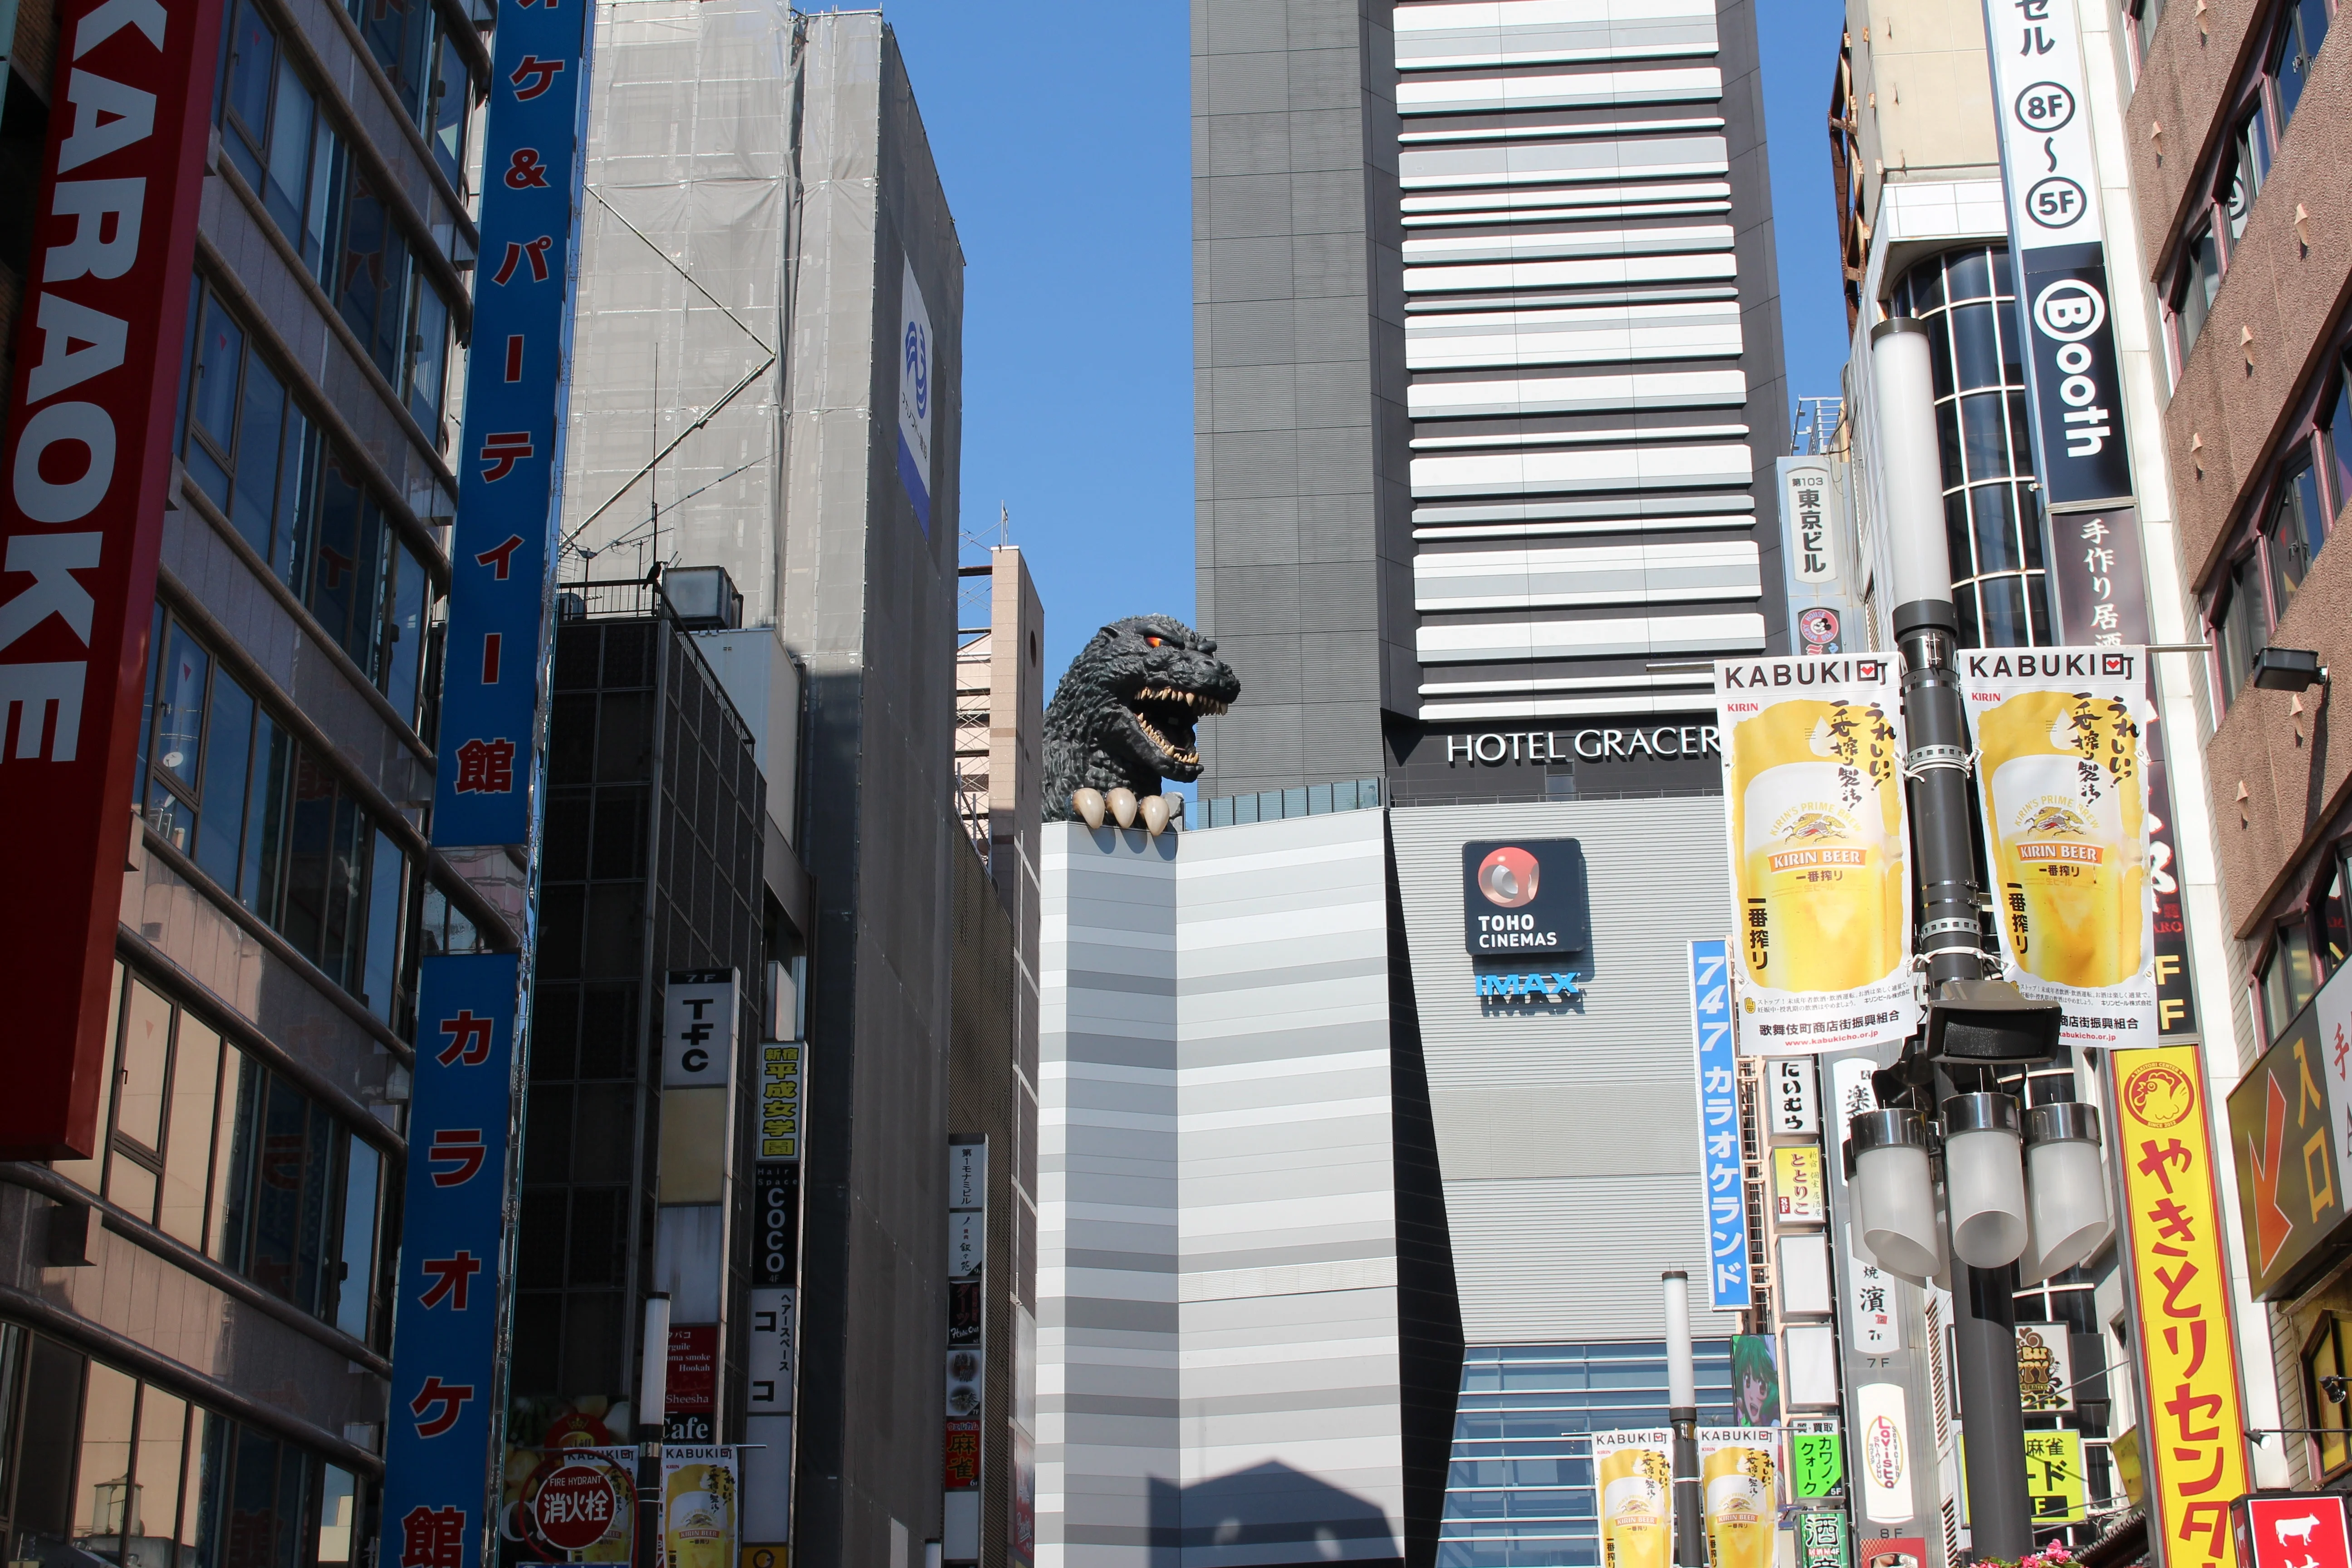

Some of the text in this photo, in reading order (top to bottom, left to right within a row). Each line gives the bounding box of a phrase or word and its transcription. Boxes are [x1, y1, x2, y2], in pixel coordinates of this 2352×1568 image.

[2027, 94, 2063, 120] 8F
[2038, 190, 2075, 216] 5F
[2033, 278, 2111, 458] Booth
[455, 0, 565, 796] ケ&パーティー館
[1792, 477, 1823, 487] 第103
[1797, 488, 1827, 573] 東京ビル
[1725, 659, 1888, 689] KABUKI町
[1969, 653, 2134, 680] KABUKI町
[1727, 702, 1759, 712] KIRIN
[1971, 692, 2001, 701] KIRIN
[1447, 725, 1723, 763] HOTEL GRACER
[1801, 801, 1835, 812] PRIME
[1837, 808, 1863, 833] BREW
[2041, 795, 2074, 808] PRIME
[2077, 804, 2100, 829] BREW
[1774, 850, 1861, 869] KIRIN BEER
[2020, 845, 2097, 861] KIRIN BEER
[1478, 914, 1534, 931] TOHO
[2007, 882, 2029, 955] 一番搾り
[1478, 931, 1557, 949] CINEMAS
[1747, 898, 1769, 970] 一番搾り
[686, 975, 716, 983] 7F
[2157, 954, 2180, 985] F
[1475, 972, 1581, 996] IMAX
[1864, 989, 1911, 1004] キリンビール株式会社
[1759, 1010, 1900, 1037] 歌舞伎町商店街振興組合
[2060, 1015, 2139, 1030] 商店街振興組合
[2161, 998, 2185, 1030] F
[681, 998, 714, 1073] TFC
[1785, 1029, 1879, 1046] www.kabukicho.or.jp
[2333, 1011, 2352, 1083] 手
[764, 1047, 799, 1062] 新宿
[2134, 1062, 2179, 1075] YAKITORI CENTER
[762, 1062, 798, 1156] 平成女学園
[1782, 1062, 1803, 1130] にいむら
[1696, 956, 1743, 1294] 747 カラオケランド
[2293, 1037, 2334, 1224] 入口
[961, 1148, 972, 1205] 第1モナミビル
[1790, 1152, 1809, 1216] ととりこ
[1780, 1197, 1789, 1214] 8F
[766, 1187, 785, 1273] COCO
[401, 1009, 495, 1568] カラオケ館
[769, 1274, 780, 1283] 4F
[1859, 1285, 1886, 1313] 濱
[779, 1294, 791, 1372] ヘアースペース
[1868, 1329, 1883, 1341] 7F
[1867, 1357, 1890, 1368] 7F
[2137, 1138, 2230, 1568] やきとりセンタ
[666, 1394, 709, 1404] Sheesha
[2021, 1394, 2049, 1410] 2F
[947, 1422, 979, 1431] ウェルカム
[1596, 1432, 1668, 1446] KABUKI町
[1701, 1430, 1773, 1443] KABUKI町
[946, 1432, 978, 1480] 麻雀
[2025, 1437, 2065, 1456] 麻雀
[550, 1475, 602, 1487] FIRE HYDRANT
[1801, 1442, 1817, 1495] クォーク
[544, 1489, 609, 1524] 消火栓
[1804, 1516, 1840, 1548] 酒
[1880, 1528, 1903, 1539] 8F
[1606, 1537, 1615, 1568] 一番搾り
[1709, 1535, 1717, 1568] 一番搾り
